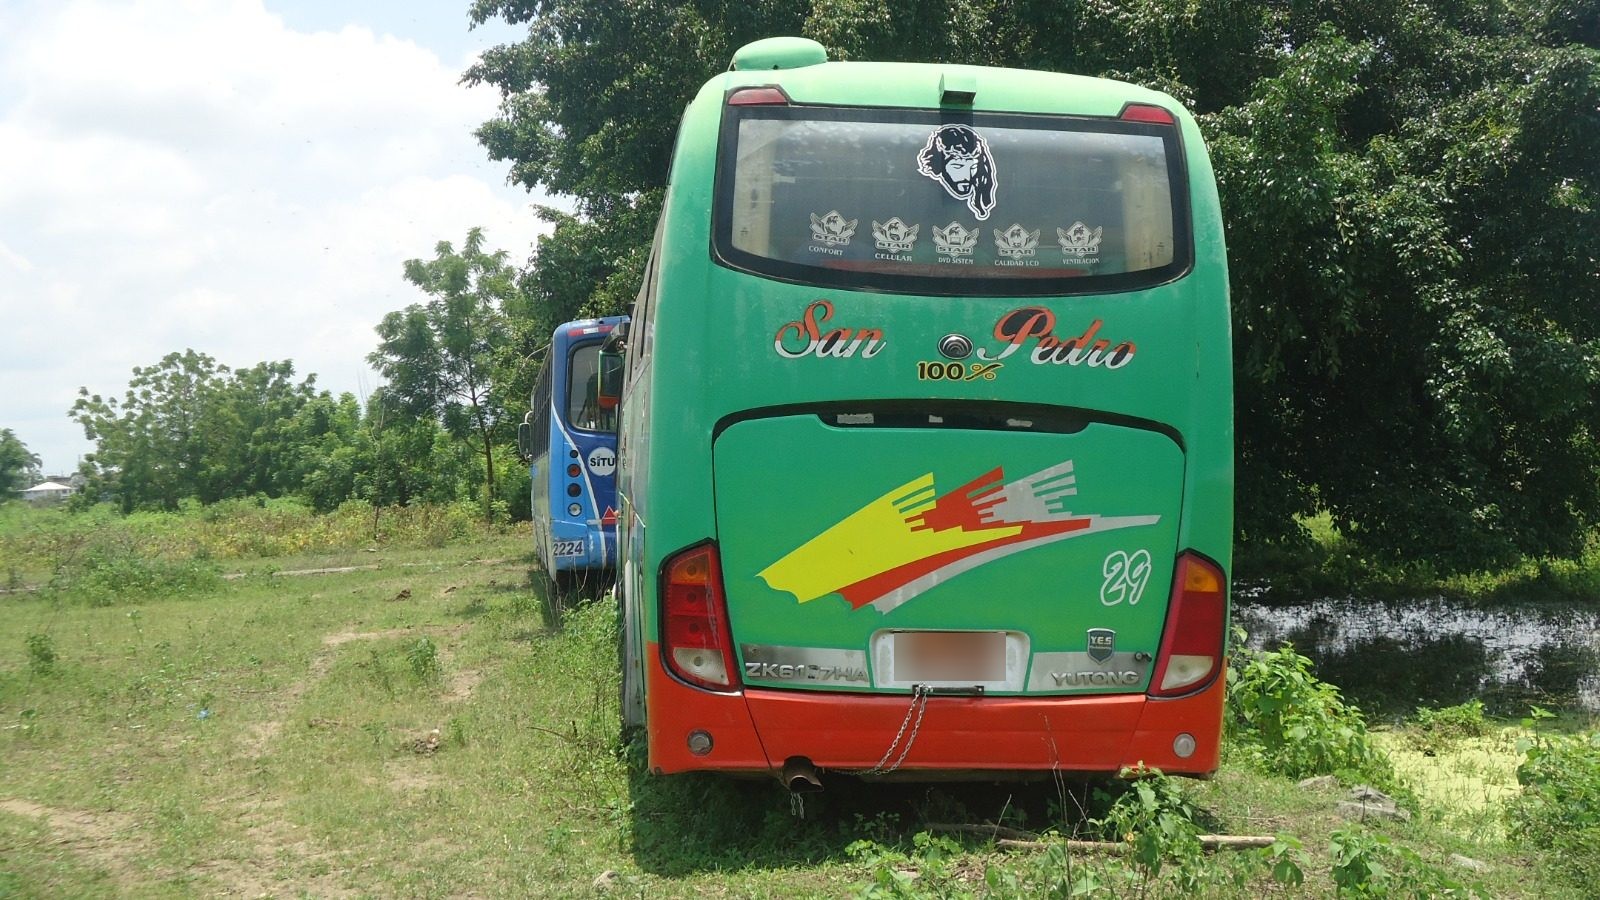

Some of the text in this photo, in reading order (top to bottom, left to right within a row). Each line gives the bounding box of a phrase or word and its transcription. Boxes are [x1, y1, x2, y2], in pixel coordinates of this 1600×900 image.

[815, 234, 848, 244] STAR
[808, 245, 844, 256] CONFORT
[874, 252, 913, 262] CELULAR
[994, 259, 1040, 267] CALIDAD LCD
[774, 300, 1137, 369] San Pedro
[1101, 549, 1152, 606] 29
[1090, 636, 1112, 645] YES
[1051, 670, 1139, 687] YUTONG
